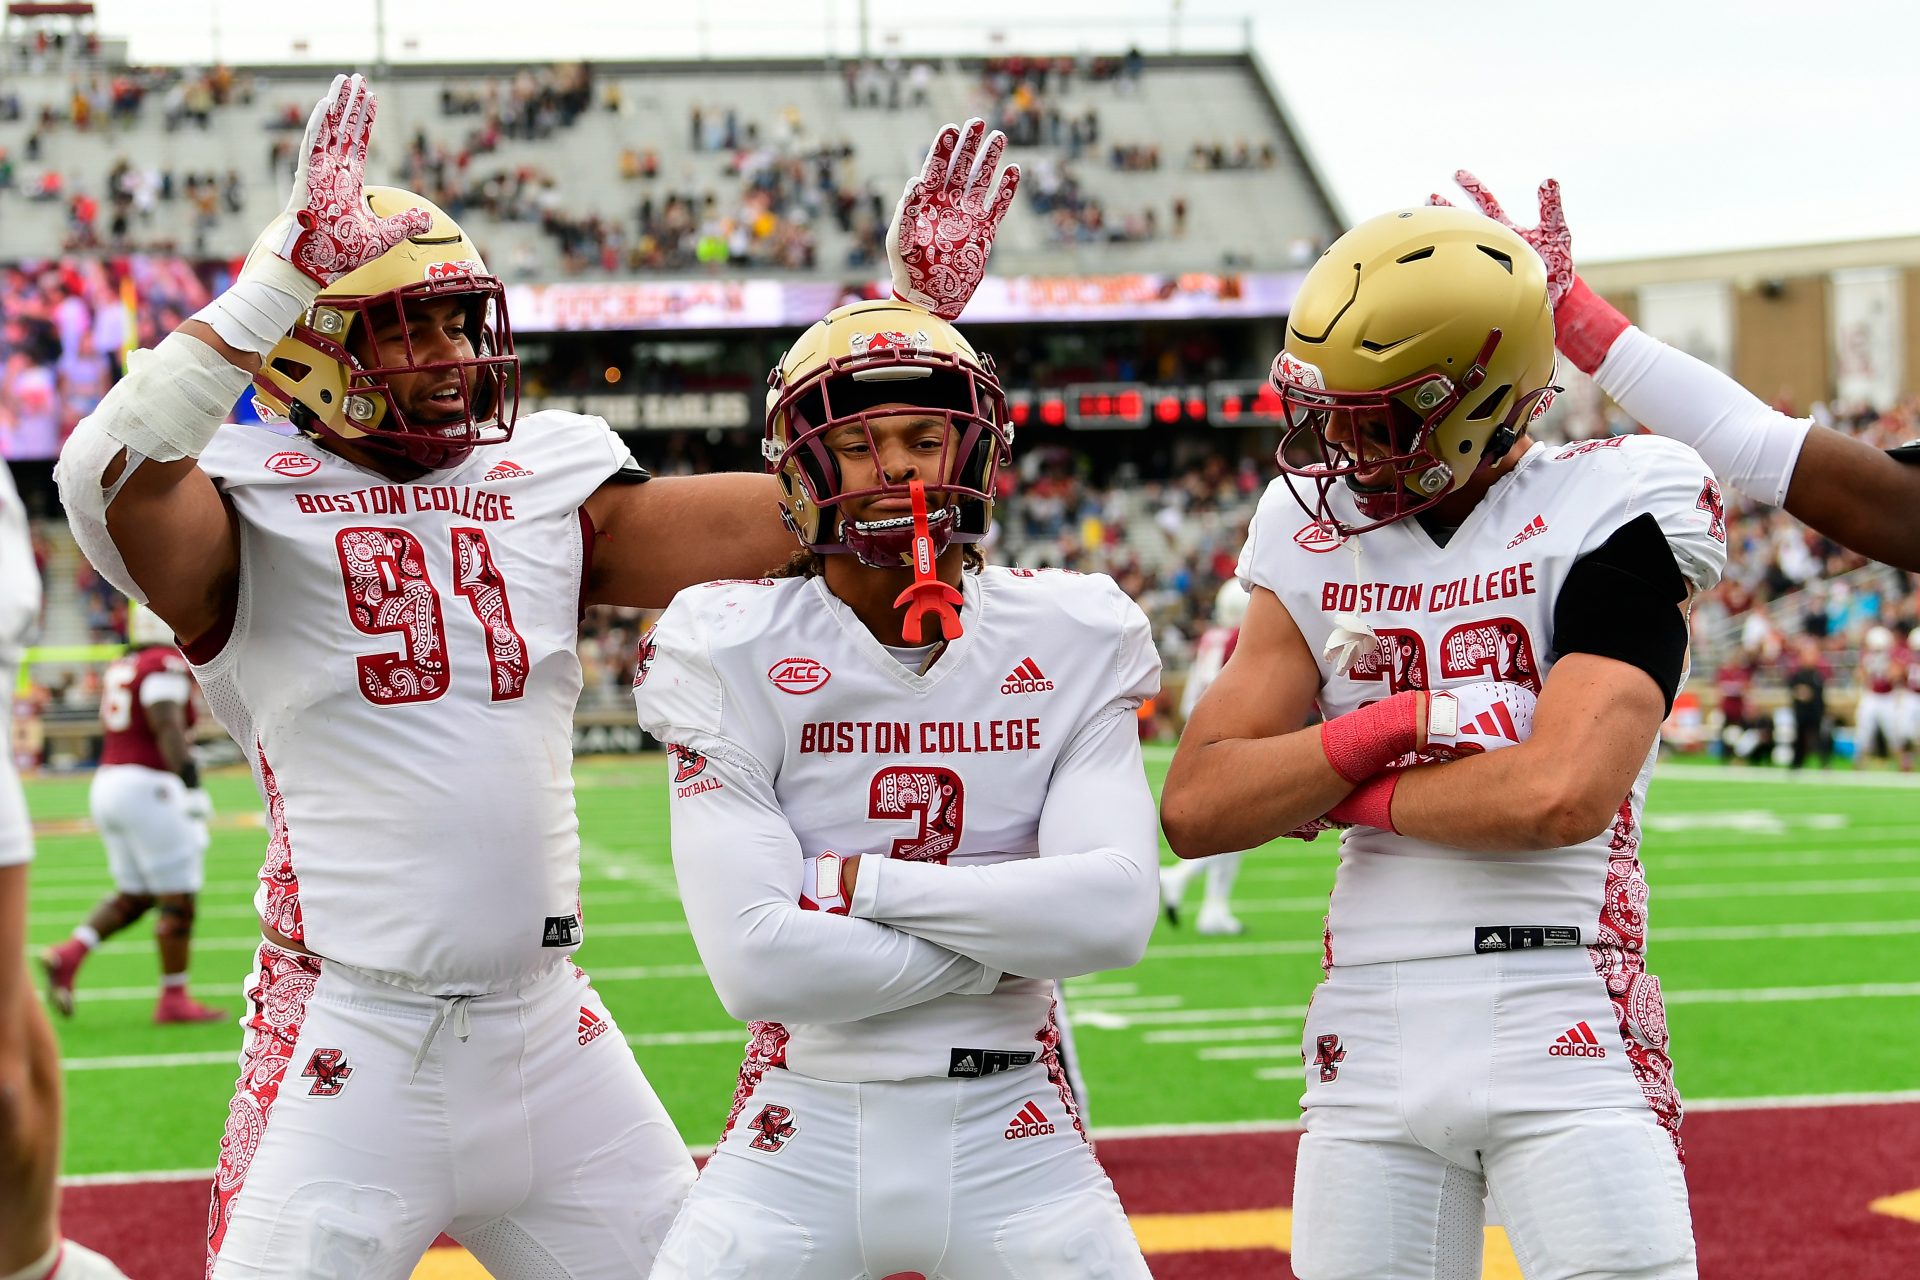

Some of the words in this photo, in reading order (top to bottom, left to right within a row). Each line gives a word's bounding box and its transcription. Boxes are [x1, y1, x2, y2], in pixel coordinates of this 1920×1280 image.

[274, 456, 312, 468] ACC
[484, 468, 534, 482] adidas
[295, 485, 407, 515] BOSTON
[413, 486, 515, 522] COLLEGE
[1506, 526, 1548, 550] adidas
[1321, 582, 1423, 613] BOSTON
[1428, 562, 1536, 613] COLLEGE
[335, 526, 531, 705] 91
[778, 666, 819, 681] ACC
[1000, 678, 1054, 694] adidas
[800, 721, 911, 754] BOSTON
[920, 717, 1041, 753] COLLEGE
[1523, 938, 1532, 947] M
[1548, 1042, 1606, 1058] adidas
[1004, 1122, 1056, 1141] adidas
